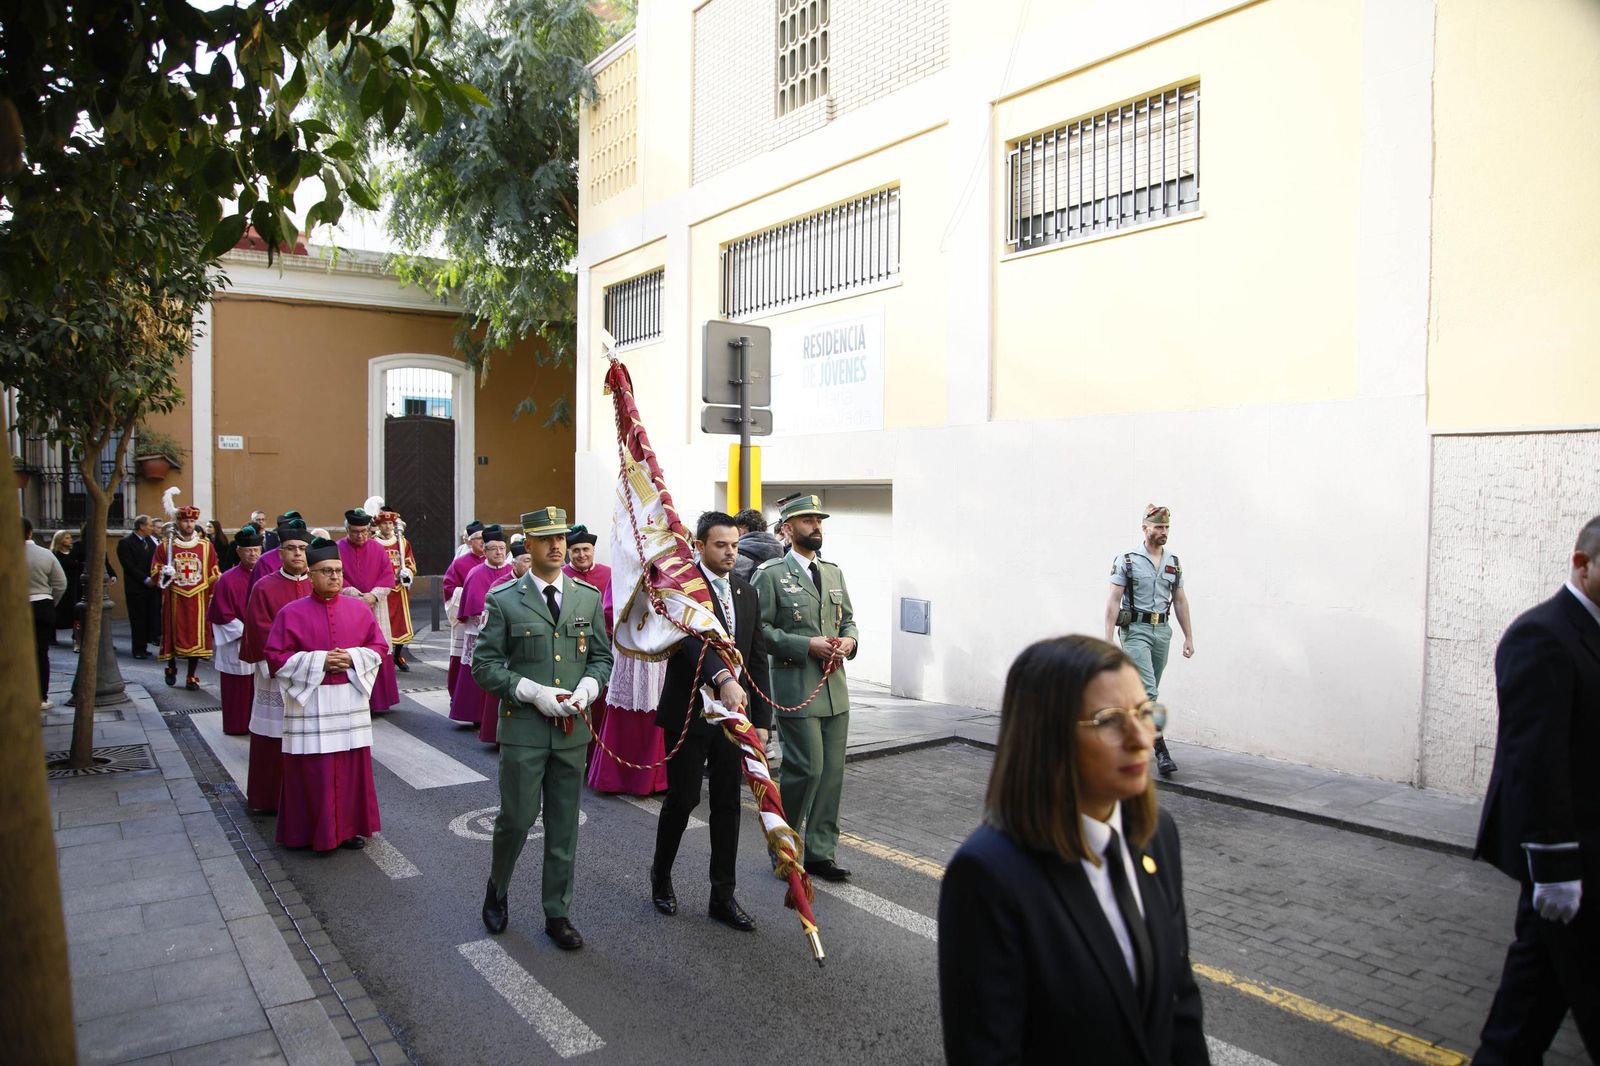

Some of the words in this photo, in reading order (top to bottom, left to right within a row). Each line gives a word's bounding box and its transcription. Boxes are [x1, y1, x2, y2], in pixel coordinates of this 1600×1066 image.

[803, 324, 866, 360] RESIDENCIA
[802, 362, 817, 389] DE
[818, 356, 867, 388] JÓVENES
